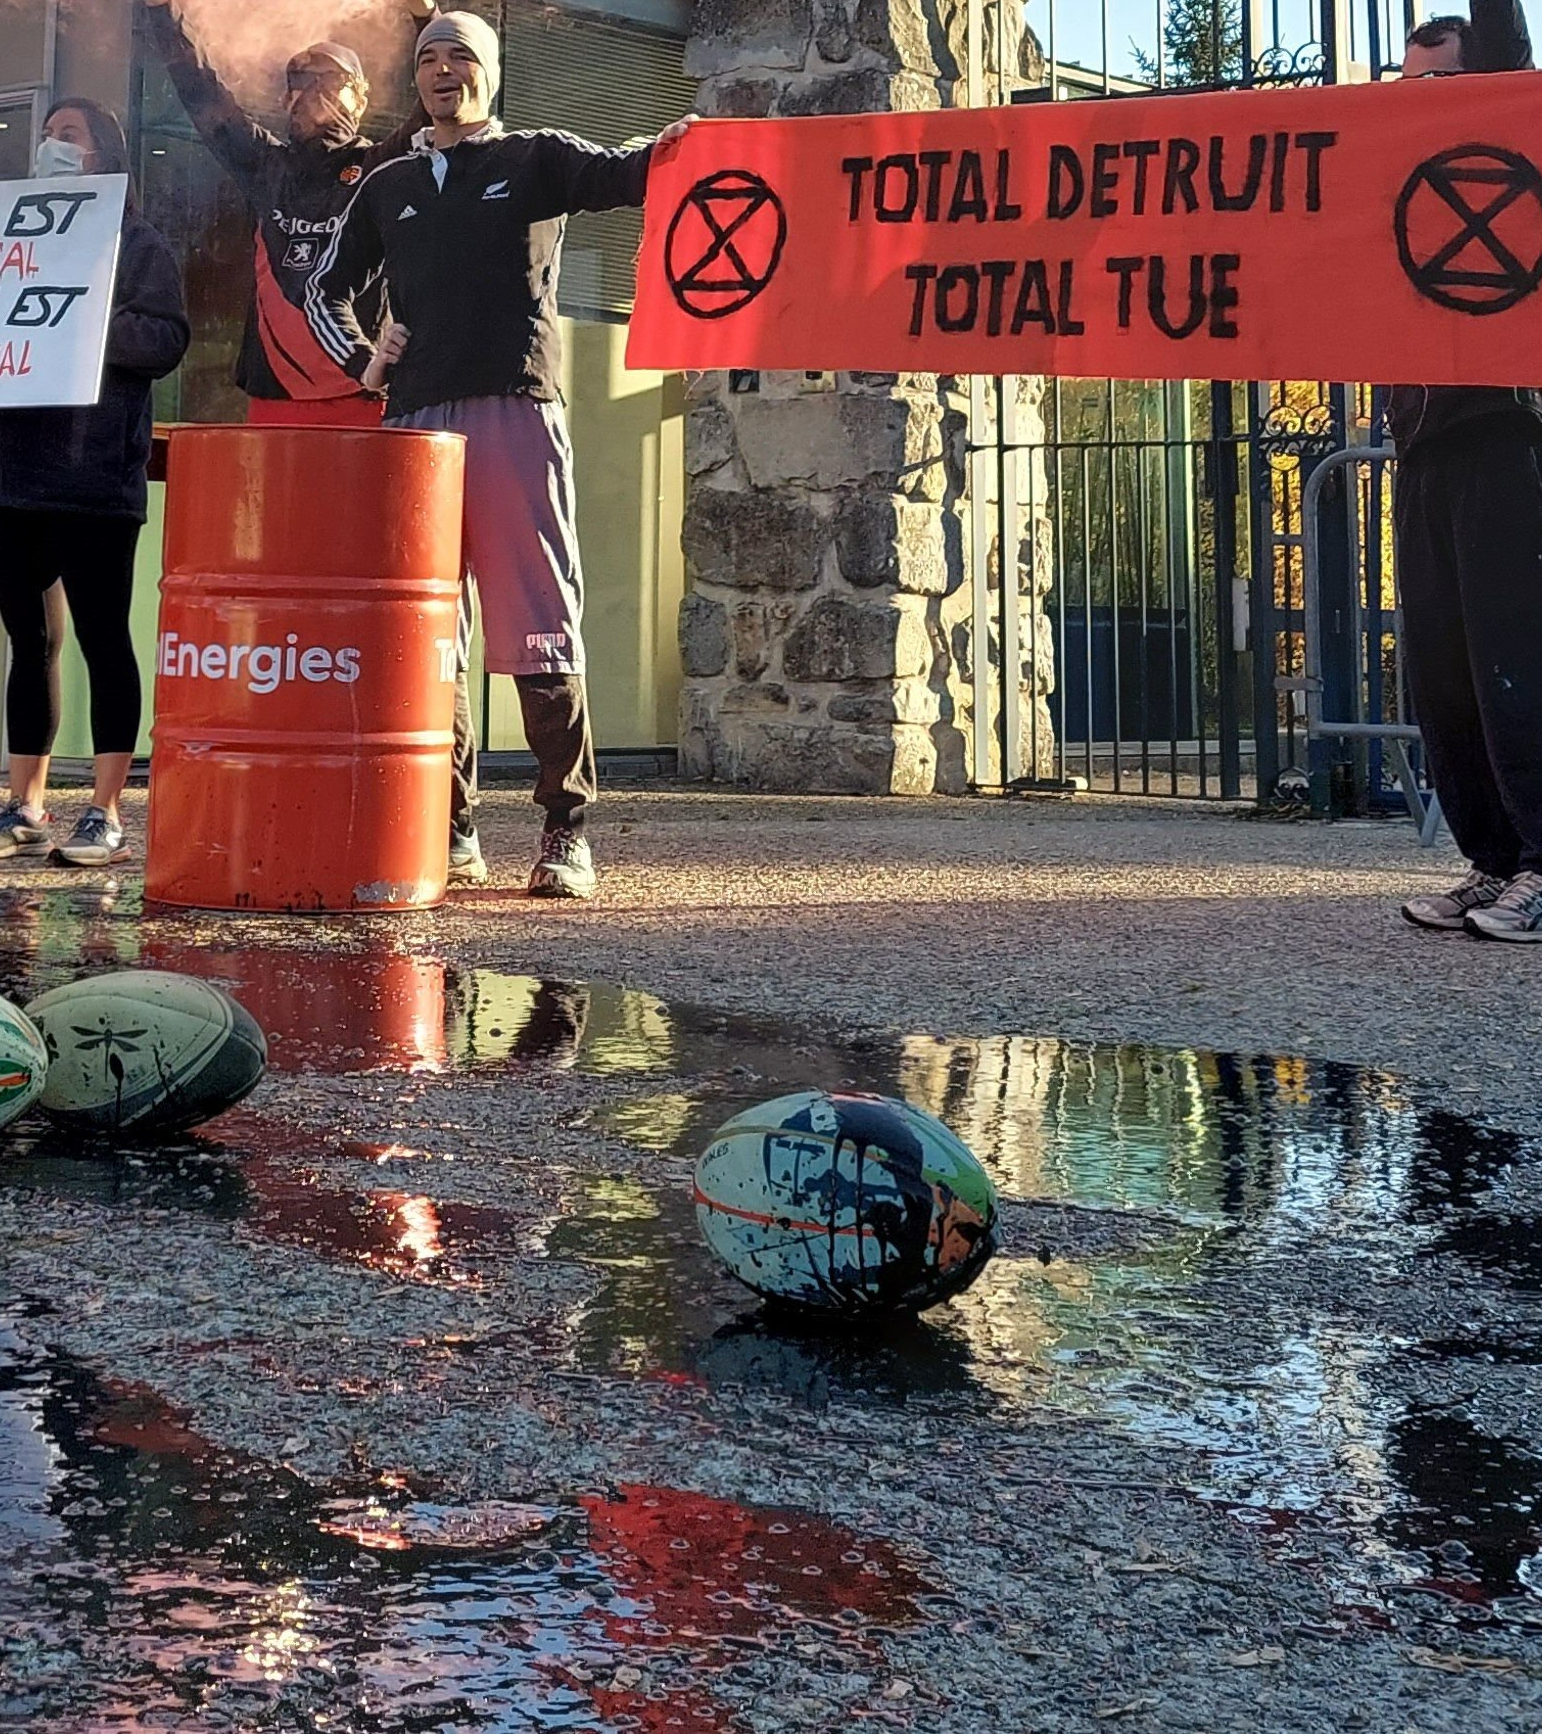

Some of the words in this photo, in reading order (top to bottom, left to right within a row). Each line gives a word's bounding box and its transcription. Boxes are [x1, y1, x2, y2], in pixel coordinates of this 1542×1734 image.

[842, 149, 1022, 224] TOTAL
[1047, 130, 1338, 220] DETRUIT
[4, 192, 97, 237] EST
[6, 286, 89, 328] EST
[905, 259, 1086, 336] TOTAL
[1106, 253, 1240, 339] TUE
